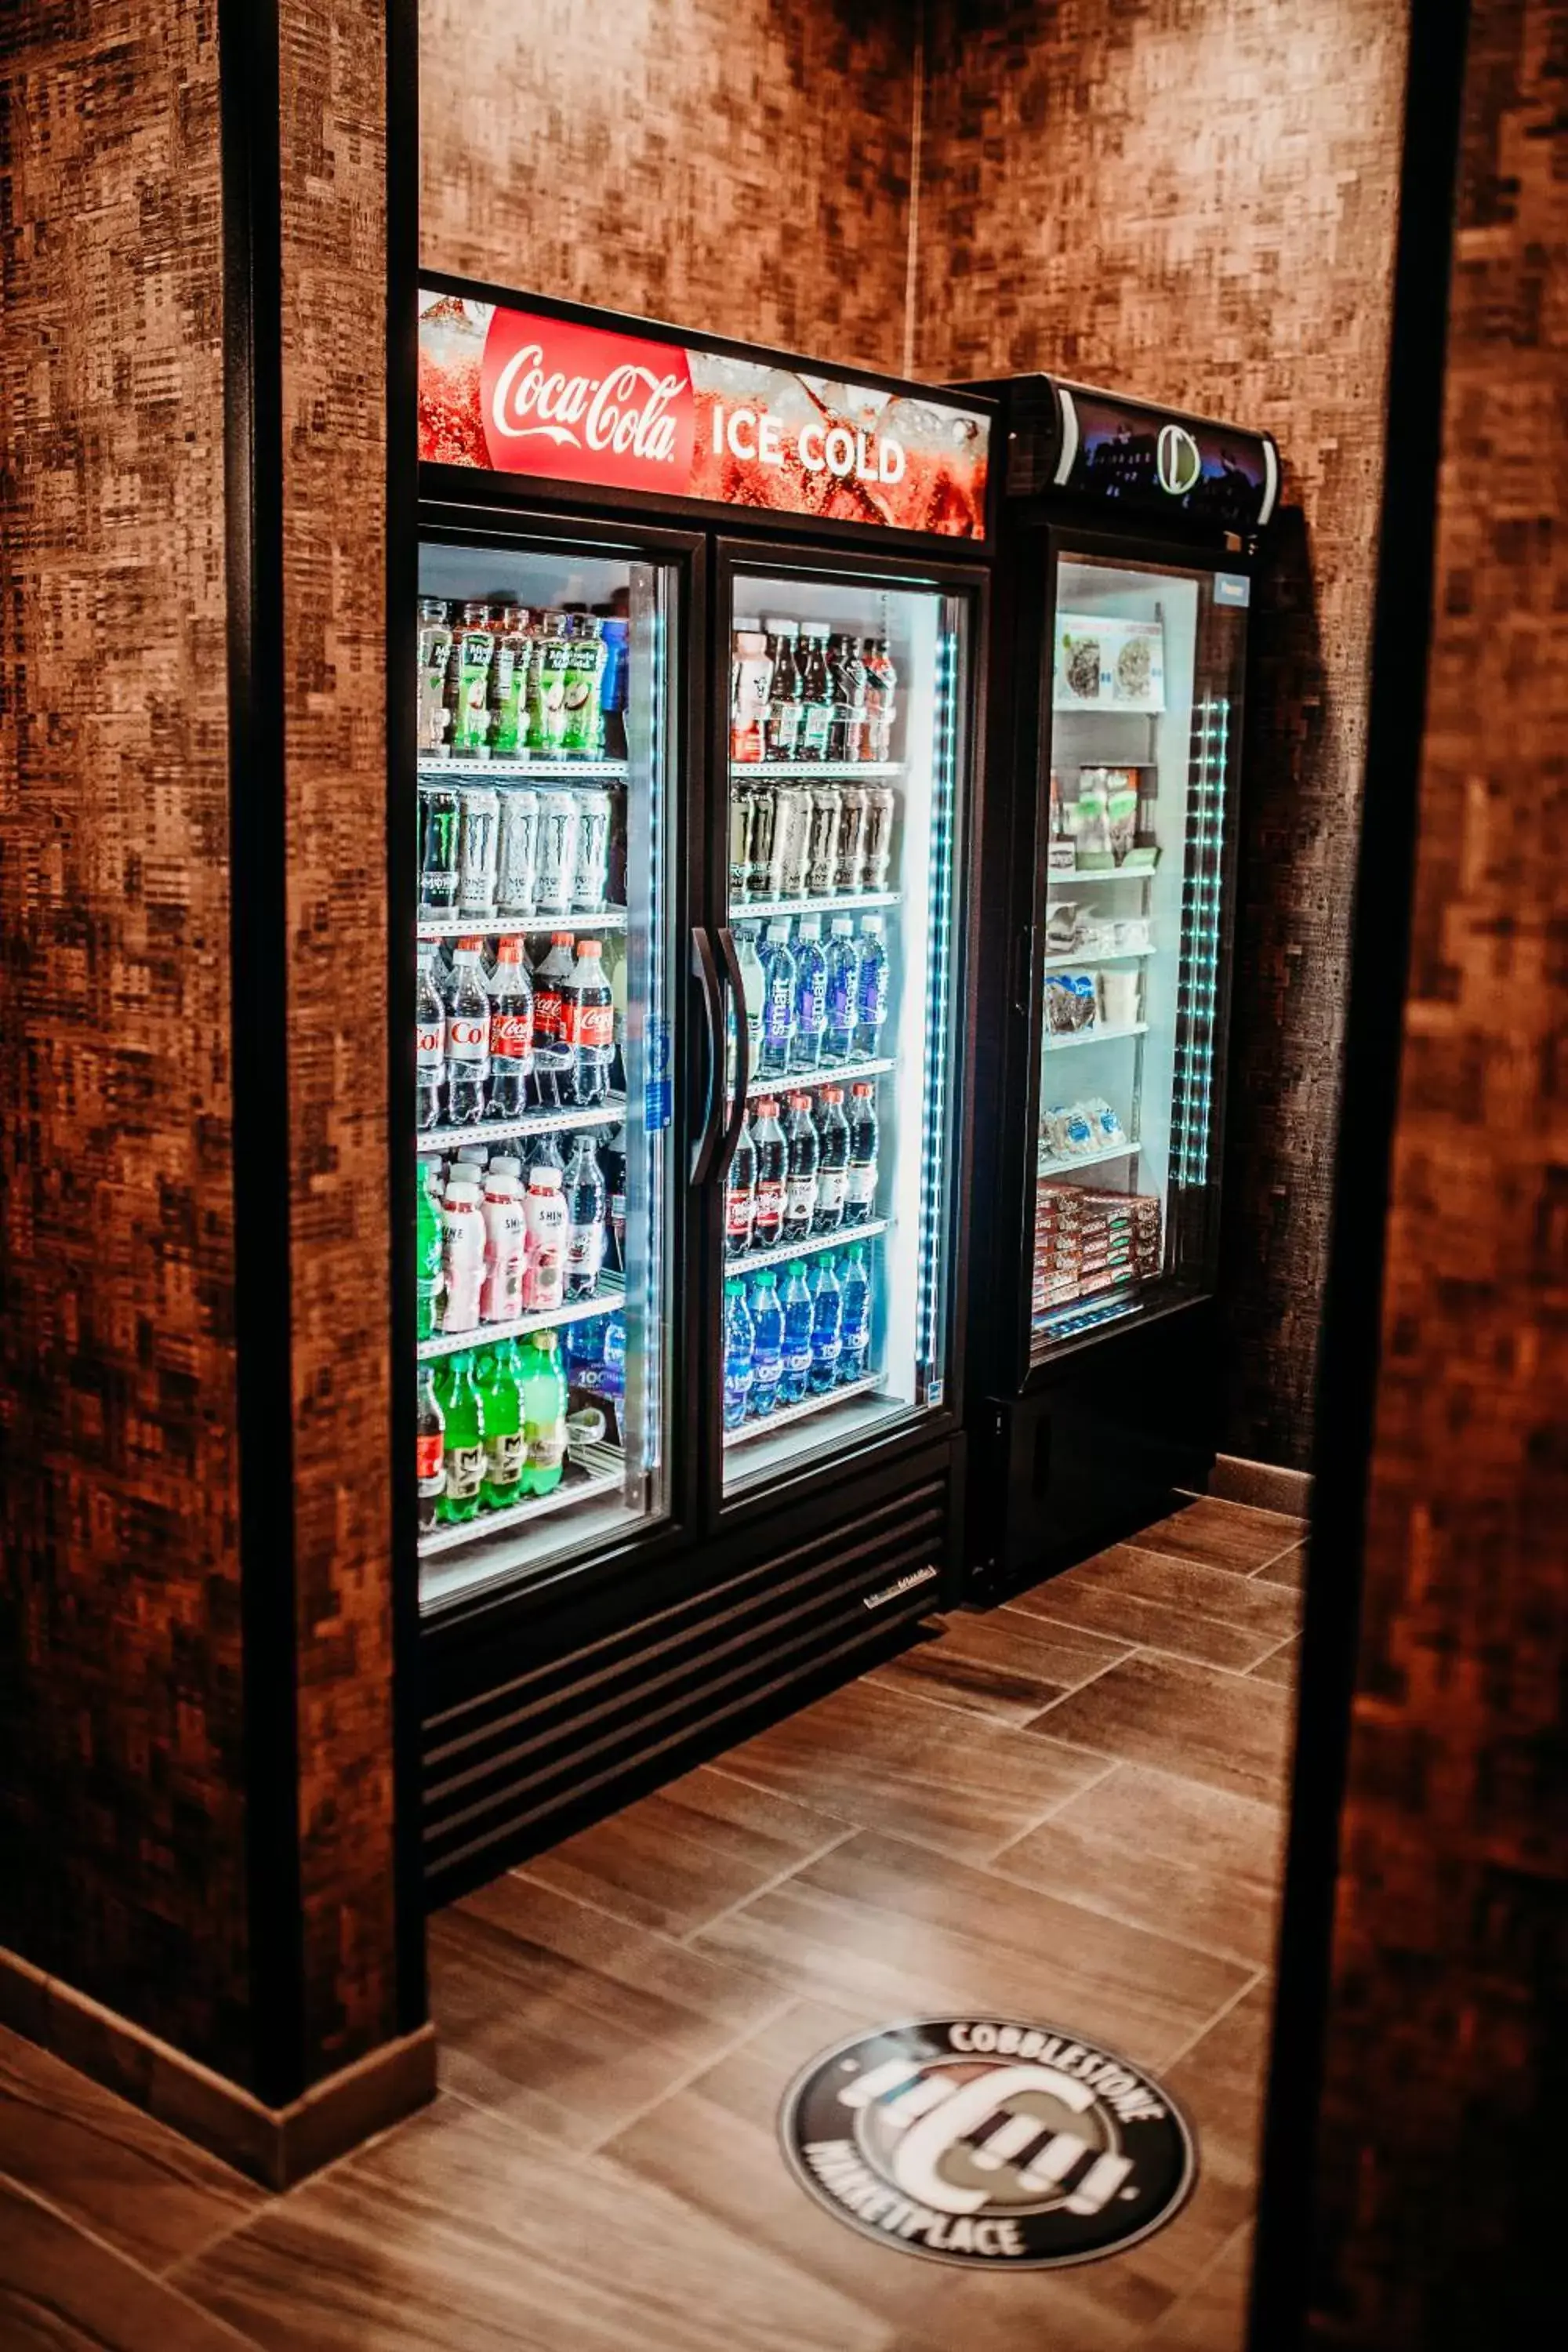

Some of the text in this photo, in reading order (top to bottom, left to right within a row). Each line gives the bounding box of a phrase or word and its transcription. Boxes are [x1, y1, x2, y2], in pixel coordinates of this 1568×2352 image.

[492, 343, 687, 463] Coca-Cola
[712, 404, 907, 485] ICE COLD
[539, 1210, 563, 1220] SHIN
[949, 2022, 1167, 2125] COBBLESTONE
[801, 2139, 1028, 2257] MARKETPLACE
